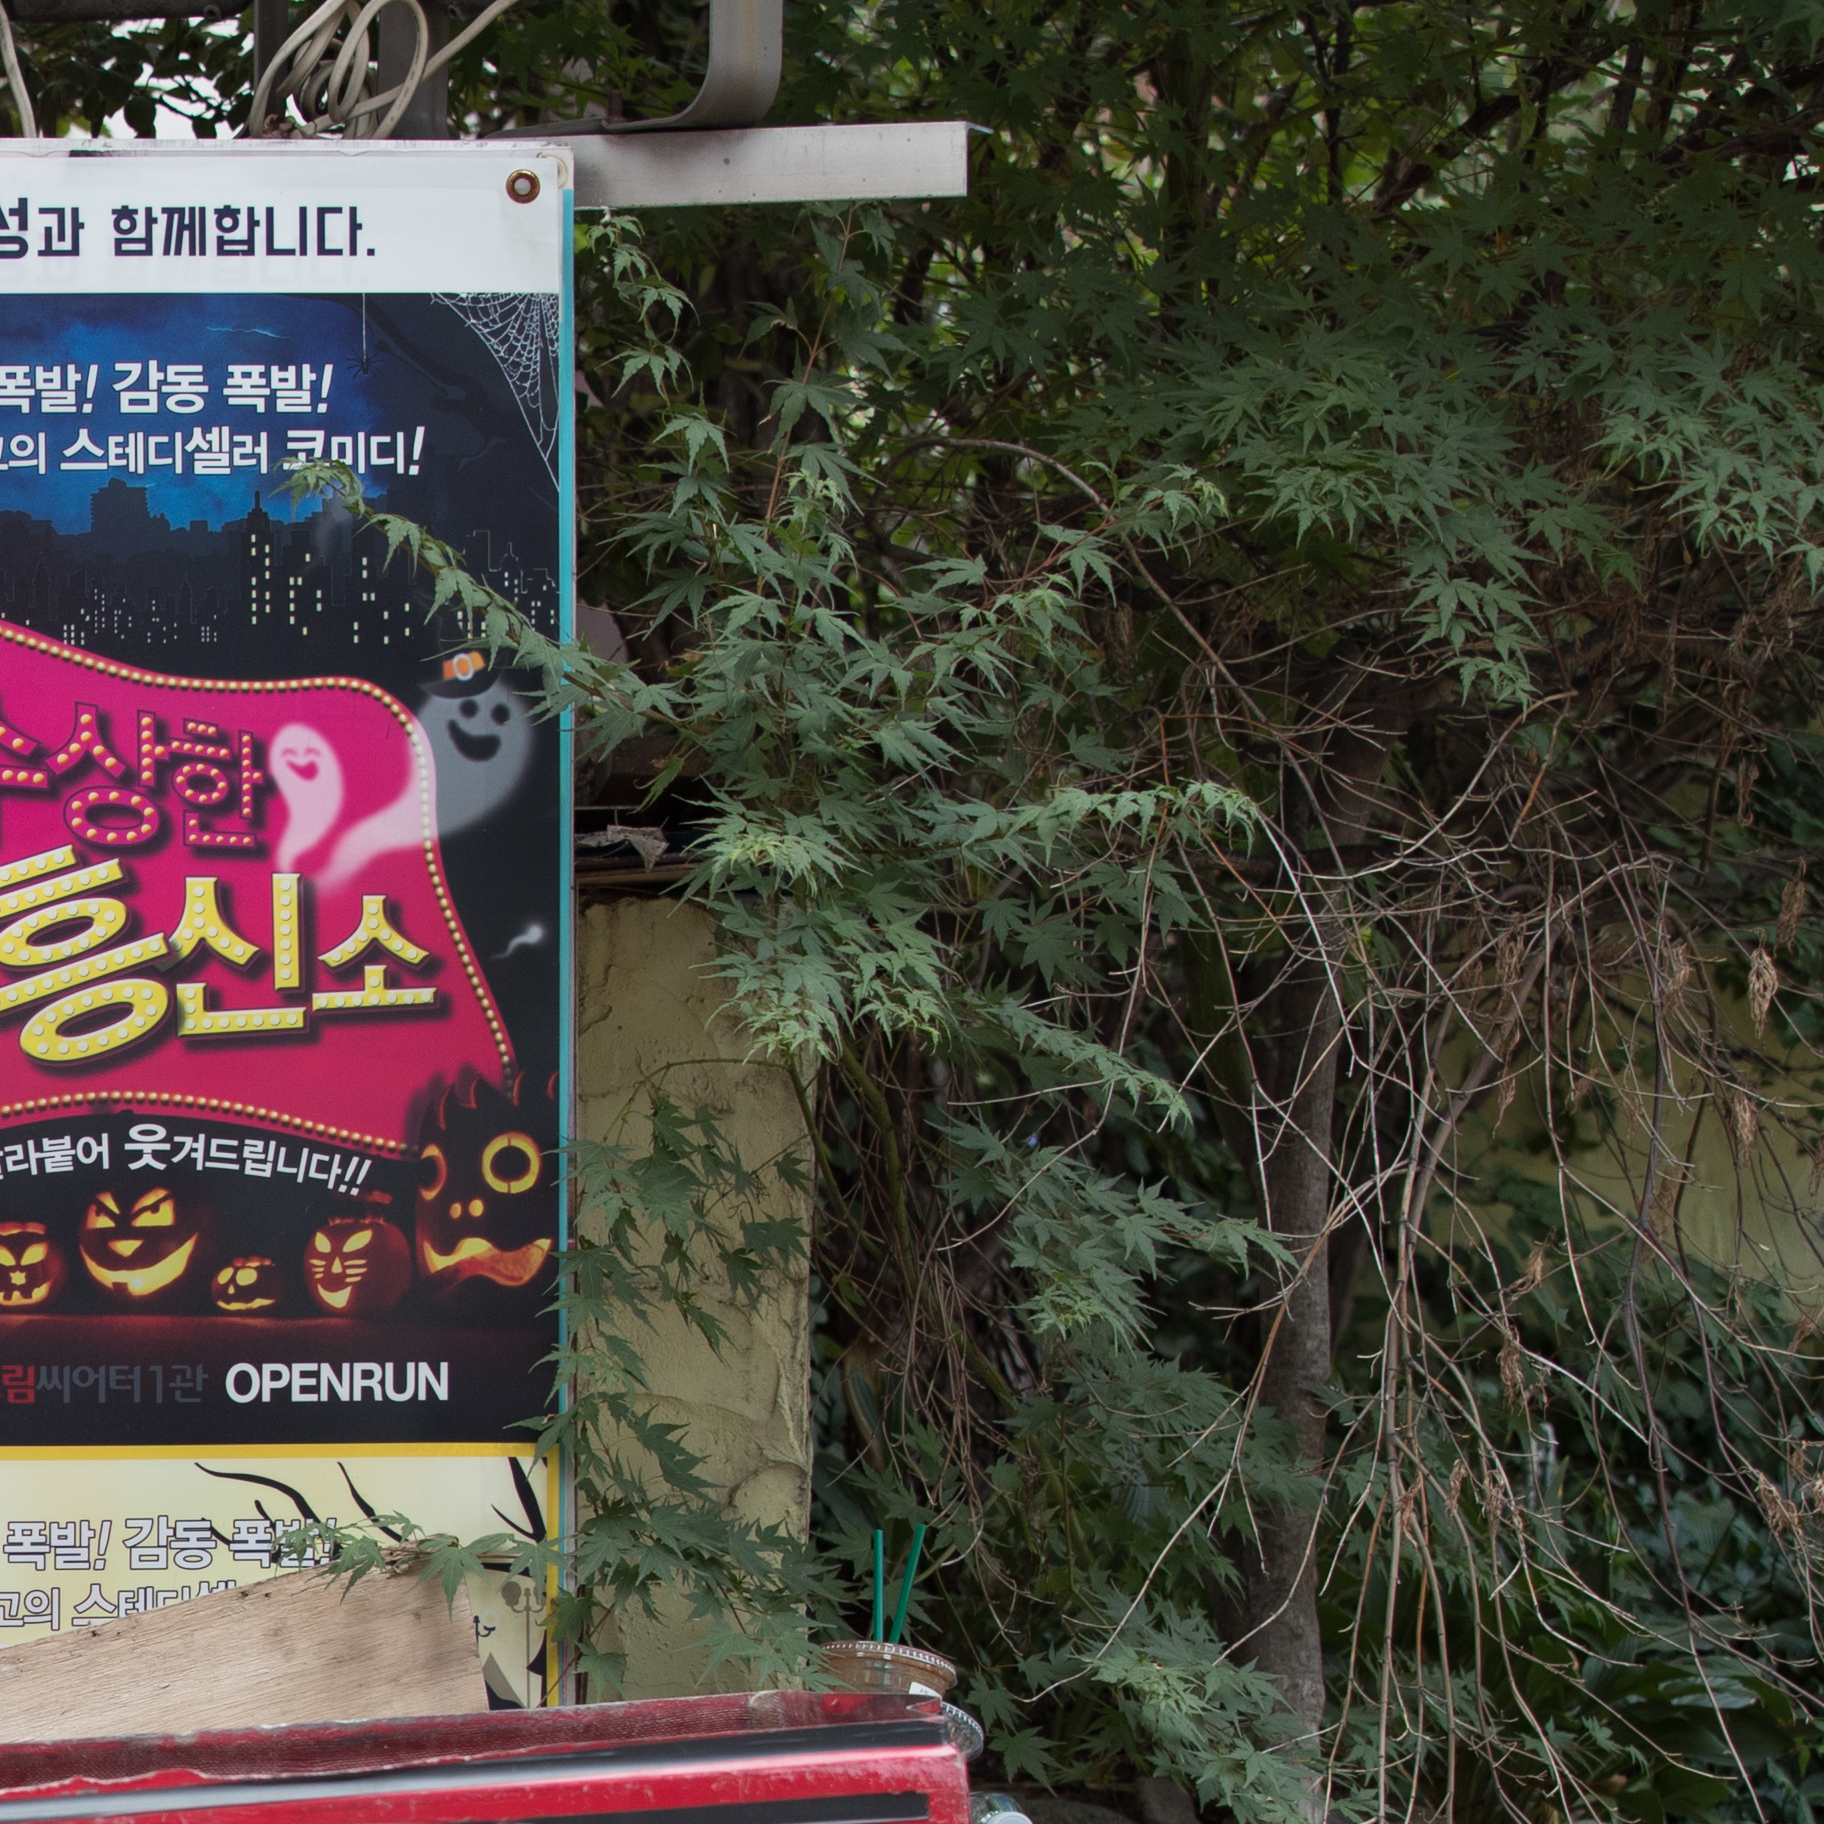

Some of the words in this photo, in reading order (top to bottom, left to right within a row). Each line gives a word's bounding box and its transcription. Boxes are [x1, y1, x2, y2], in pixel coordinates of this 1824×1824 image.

[112, 203, 377, 260] 함께합니다.
[110, 362, 211, 414] 감동
[223, 360, 335, 414] 폭발!
[60, 426, 272, 478] 스테디셀러
[282, 424, 425, 478] 코미디!
[123, 1122, 372, 1197] 웃겨드립니다!!
[225, 1360, 450, 1404] OPENRUN
[3, 1519, 112, 1571] 폭발!
[122, 1515, 217, 1570] 감동
